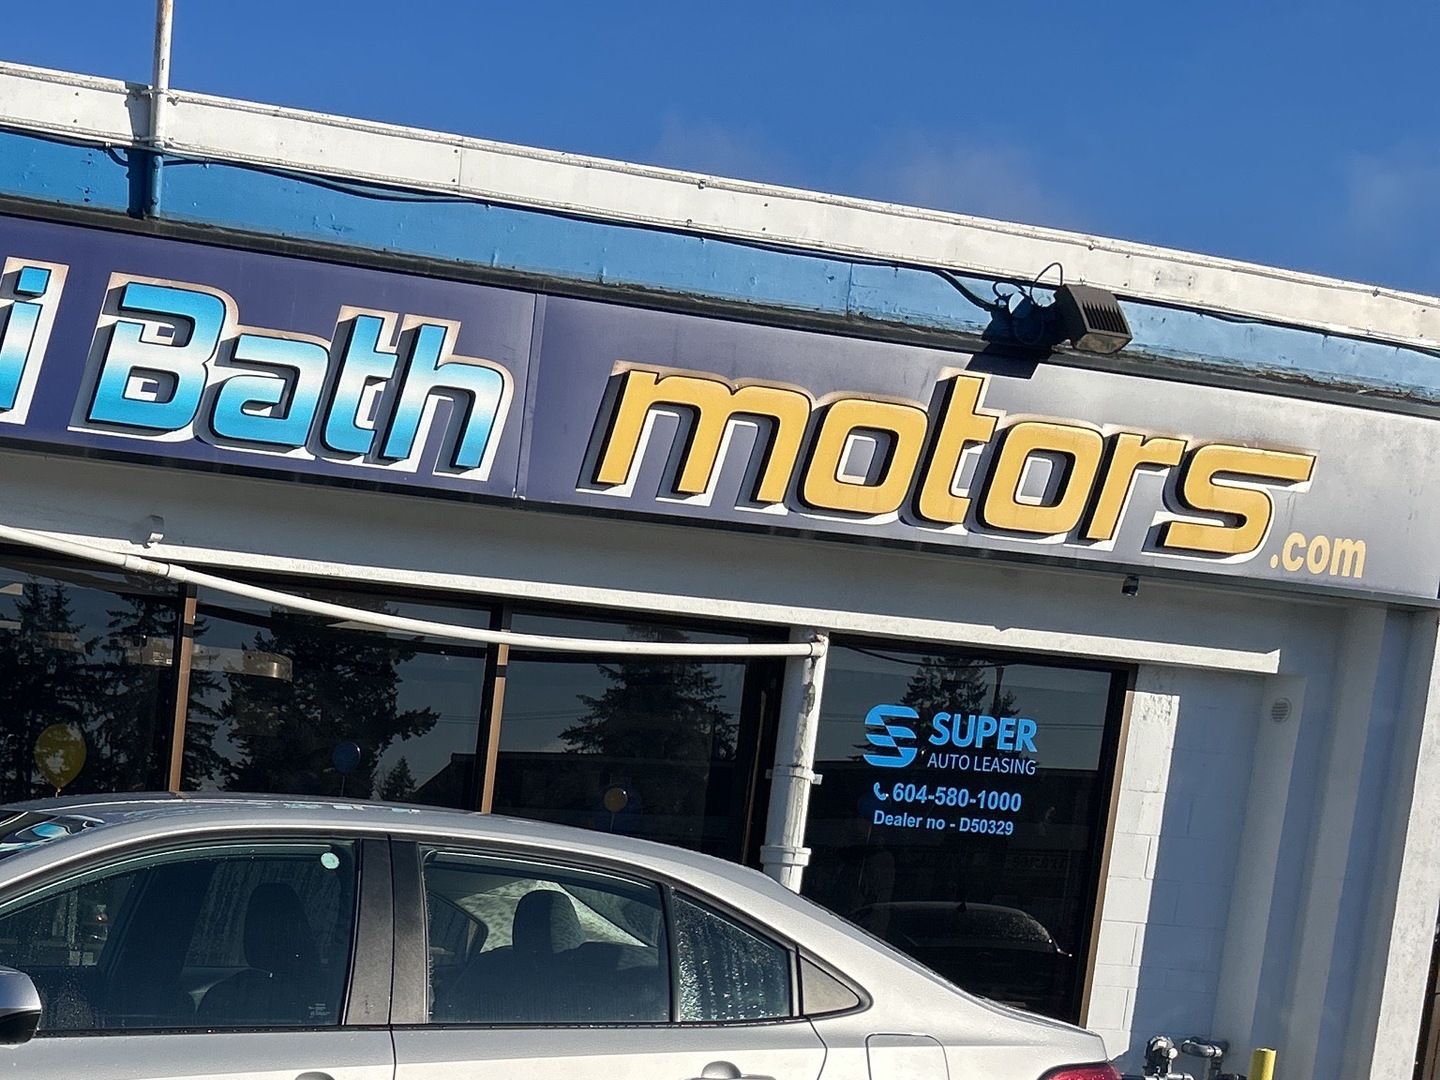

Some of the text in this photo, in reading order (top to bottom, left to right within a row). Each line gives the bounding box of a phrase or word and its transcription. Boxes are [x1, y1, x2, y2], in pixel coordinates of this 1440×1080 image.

[67, 271, 514, 482] Bath
[576, 360, 1319, 564] motors
[1270, 532, 1367, 578] .com
[928, 711, 1038, 752] SUPER
[927, 752, 1036, 775] AUTO LEASING
[892, 783, 1022, 812] 604-580-1000
[873, 810, 923, 828] Dealer
[926, 818, 945, 830] no
[959, 817, 1014, 836] D50329
